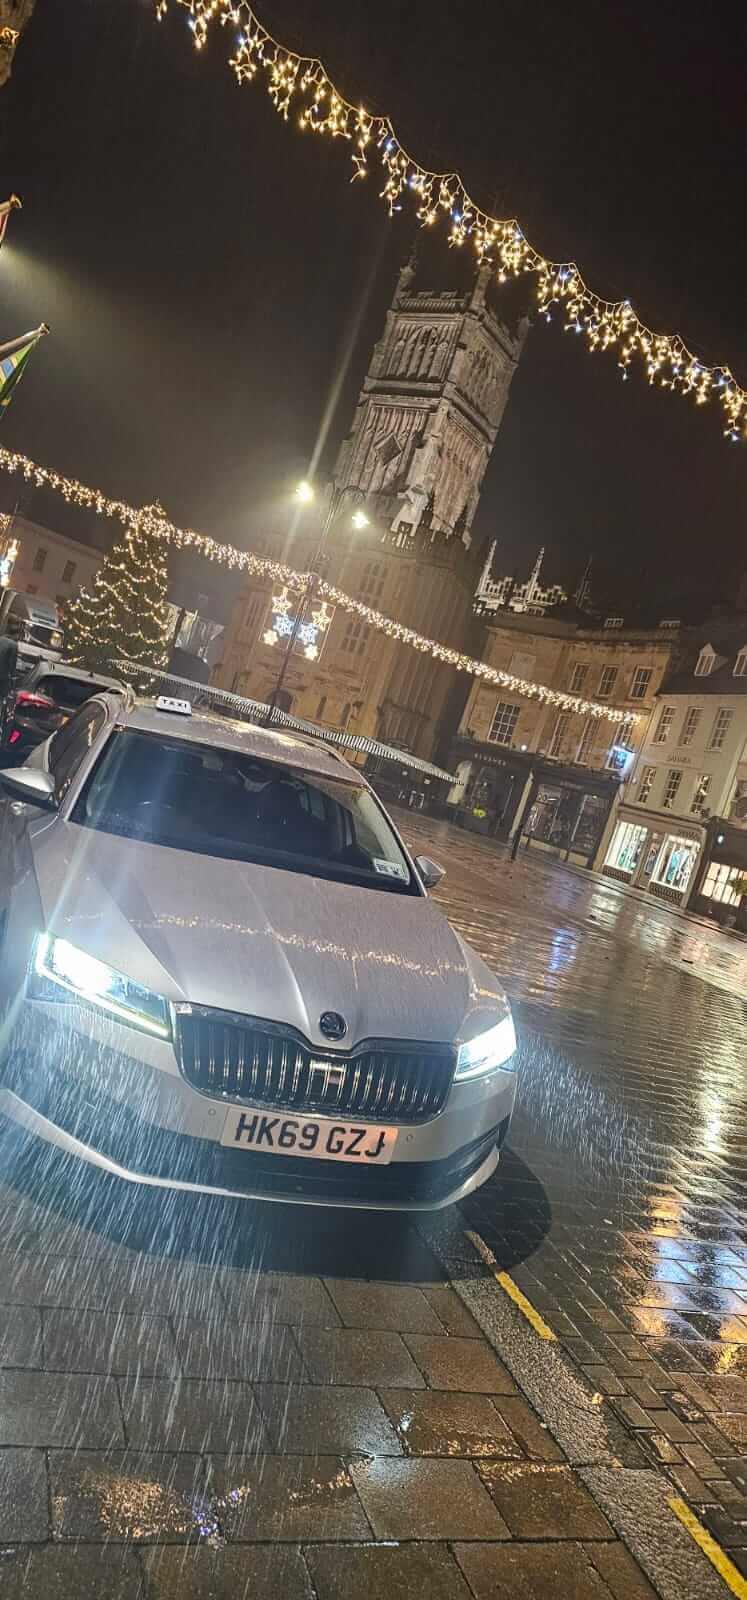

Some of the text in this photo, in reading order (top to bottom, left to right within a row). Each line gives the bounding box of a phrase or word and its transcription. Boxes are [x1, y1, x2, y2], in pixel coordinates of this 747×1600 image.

[163, 699, 188, 709] TAXI
[234, 1112, 386, 1158] HK69 GZJ
